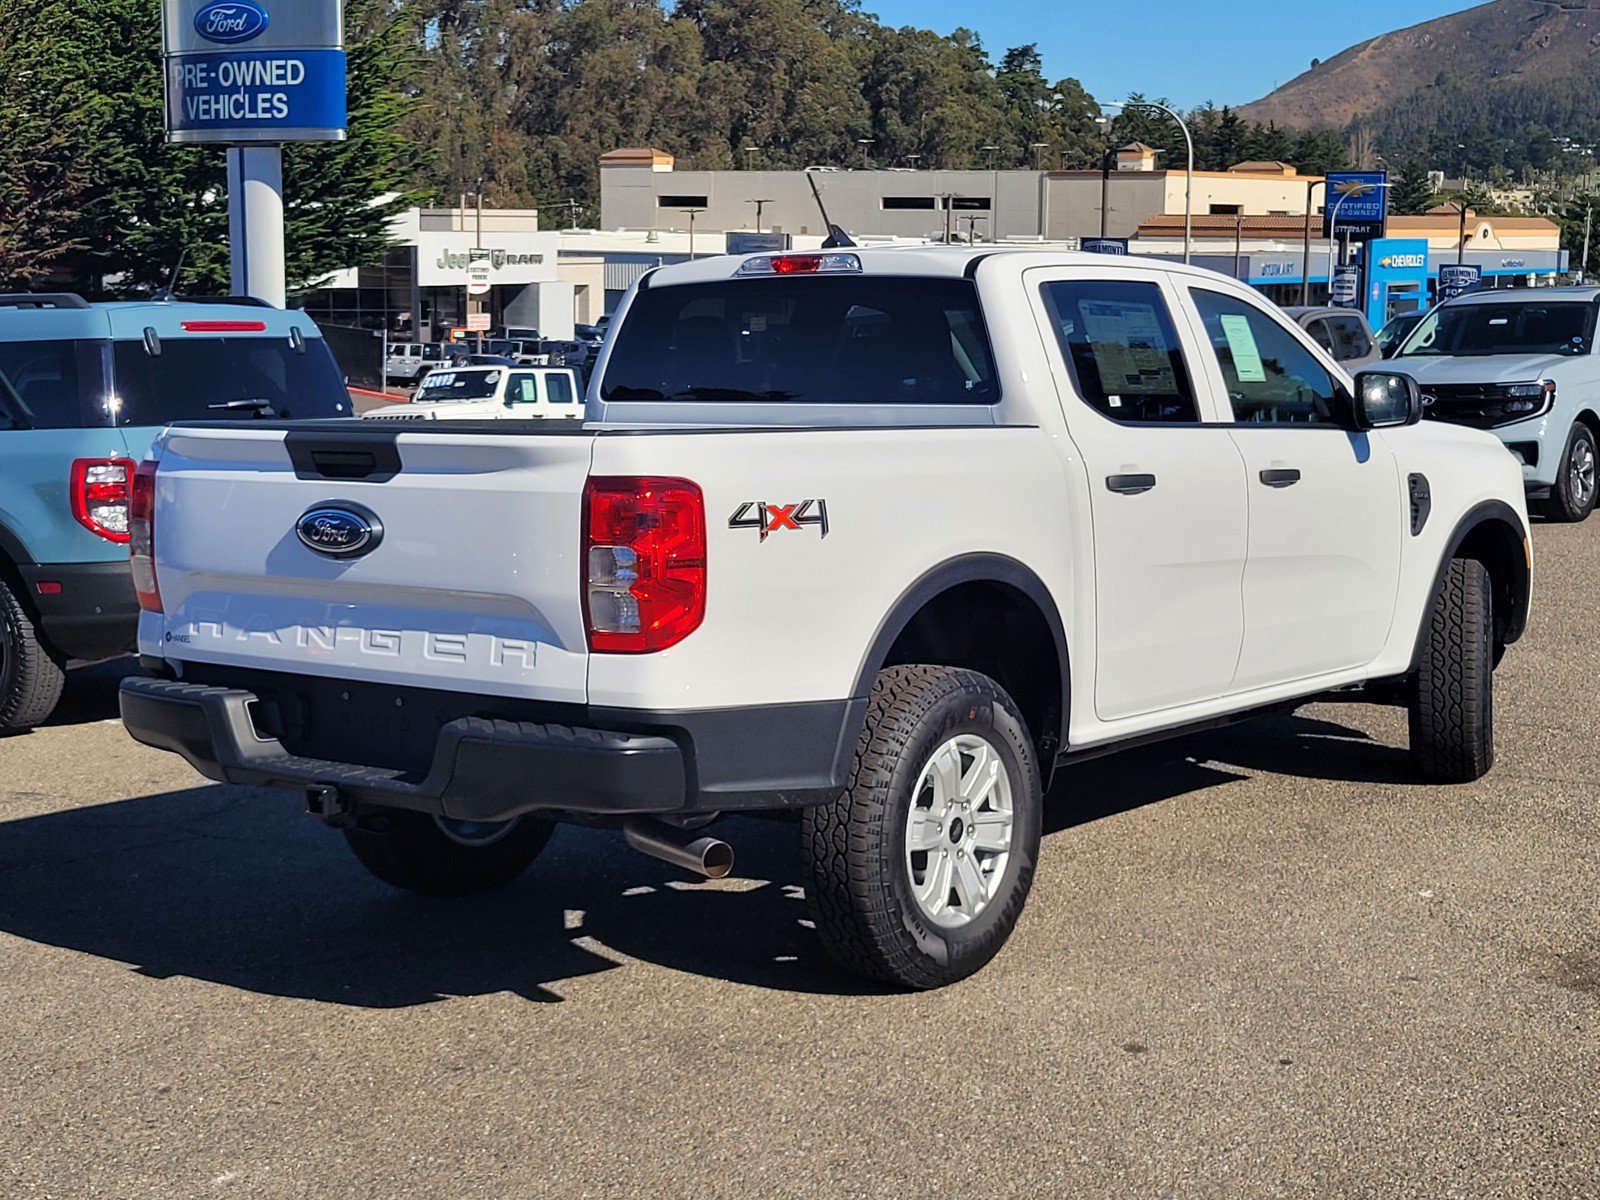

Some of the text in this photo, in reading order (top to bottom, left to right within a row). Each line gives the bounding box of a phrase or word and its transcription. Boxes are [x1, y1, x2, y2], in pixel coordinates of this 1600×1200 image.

[206, 8, 247, 33] Ford
[174, 59, 305, 91] PRE-OWNED
[186, 92, 289, 121] VEHICLES
[506, 254, 544, 266] RAM
[311, 517, 350, 542] Ford
[186, 596, 538, 670] RANGER
